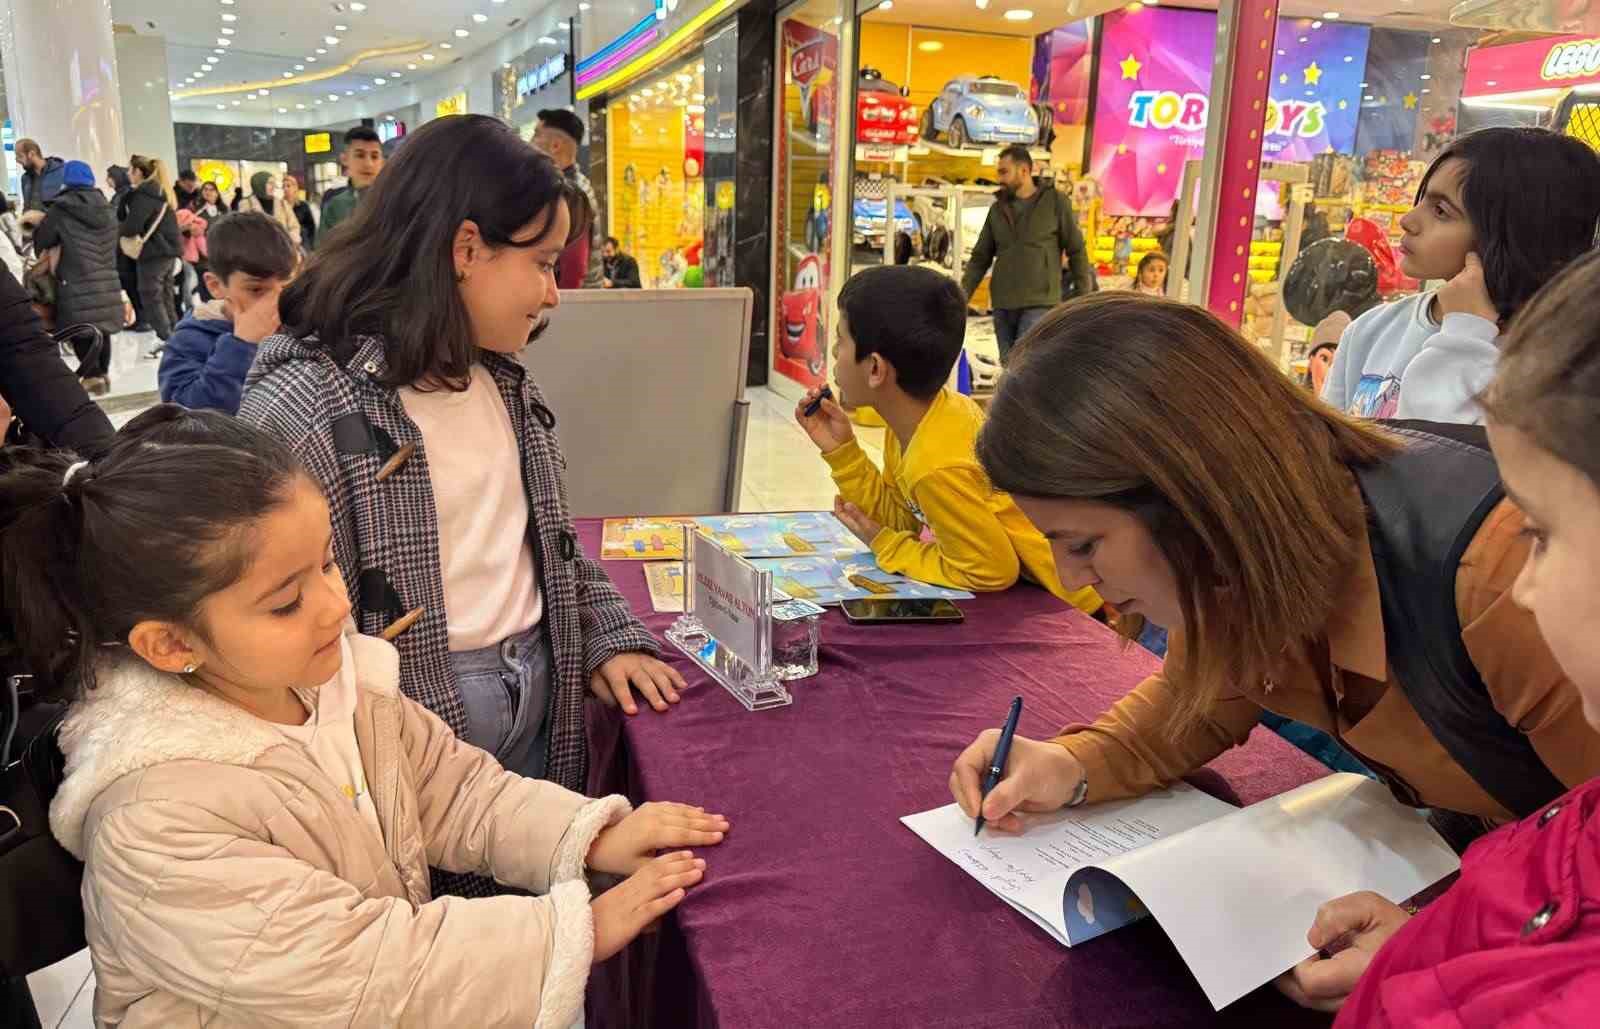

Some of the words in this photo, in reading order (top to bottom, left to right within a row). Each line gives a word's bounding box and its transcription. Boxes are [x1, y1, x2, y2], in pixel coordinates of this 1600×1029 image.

[1542, 41, 1600, 79] LEGO
[1130, 92, 1209, 128] TOR
[1264, 100, 1326, 136] OYS
